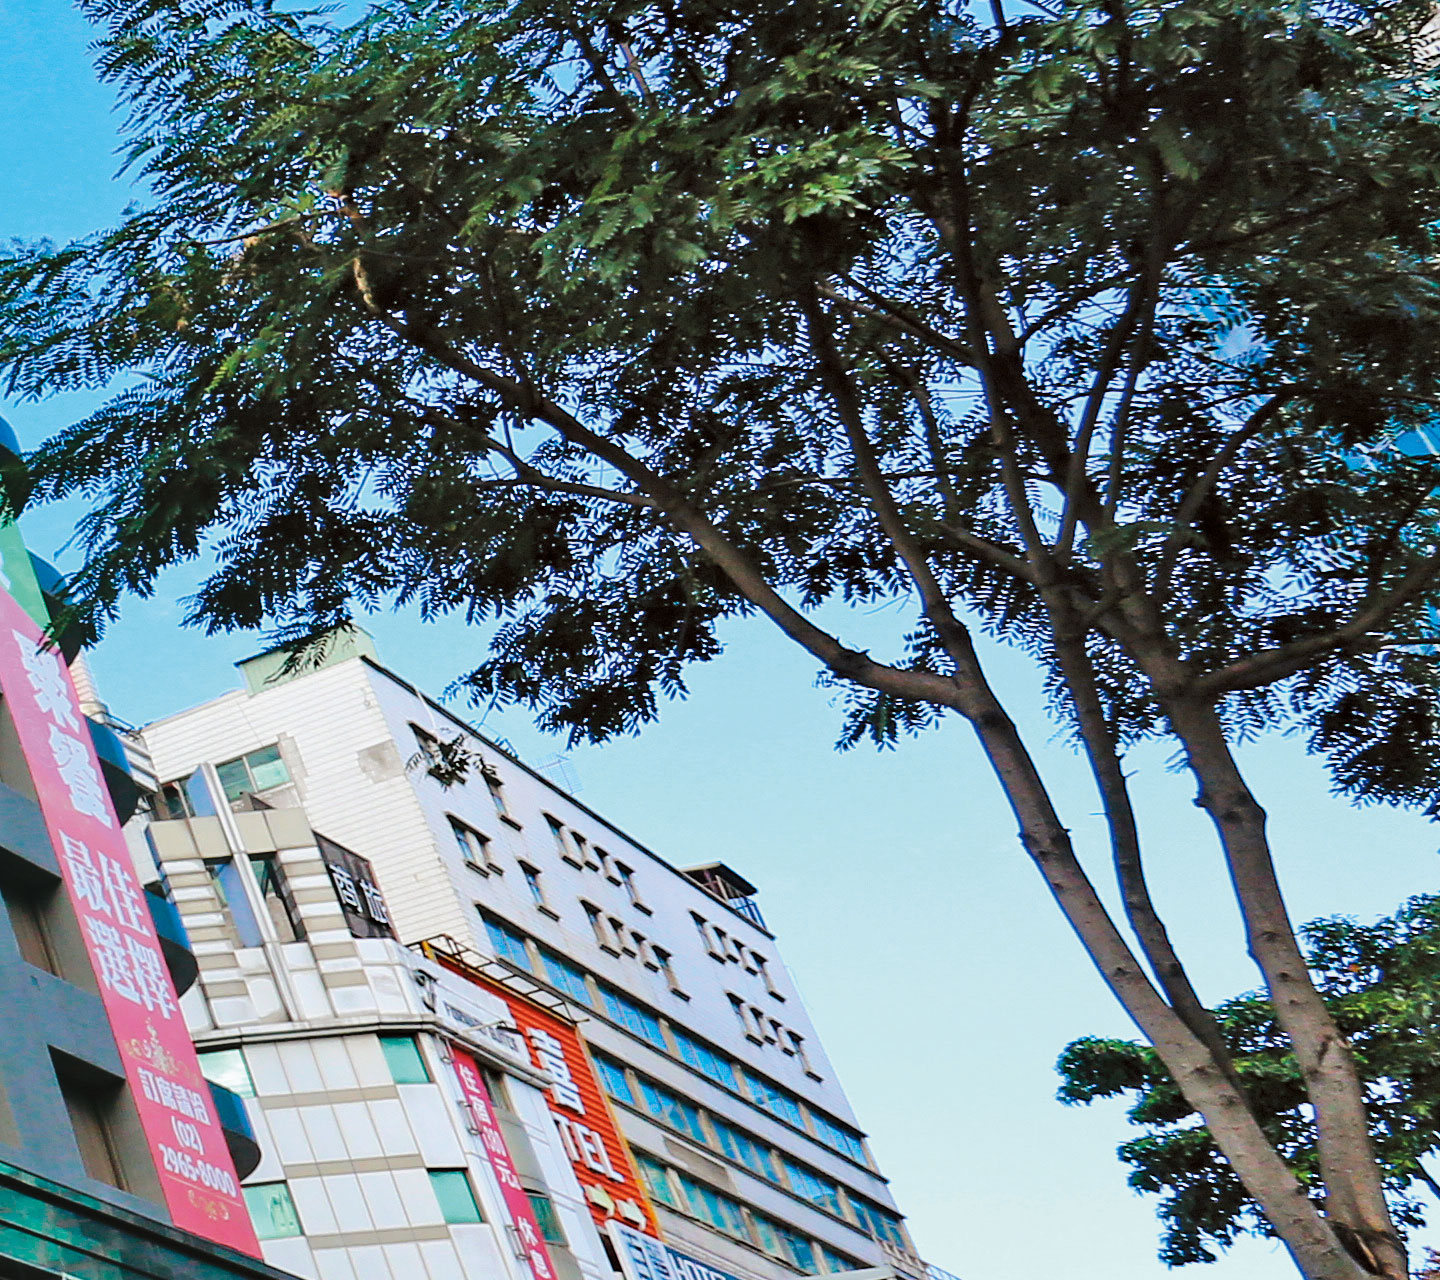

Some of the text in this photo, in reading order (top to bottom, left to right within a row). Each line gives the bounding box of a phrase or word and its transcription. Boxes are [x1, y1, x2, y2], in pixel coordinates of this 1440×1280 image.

[12, 628, 112, 829] 聚餐
[171, 1116, 205, 1156] (02)
[158, 1143, 238, 1199] 2965-8000
